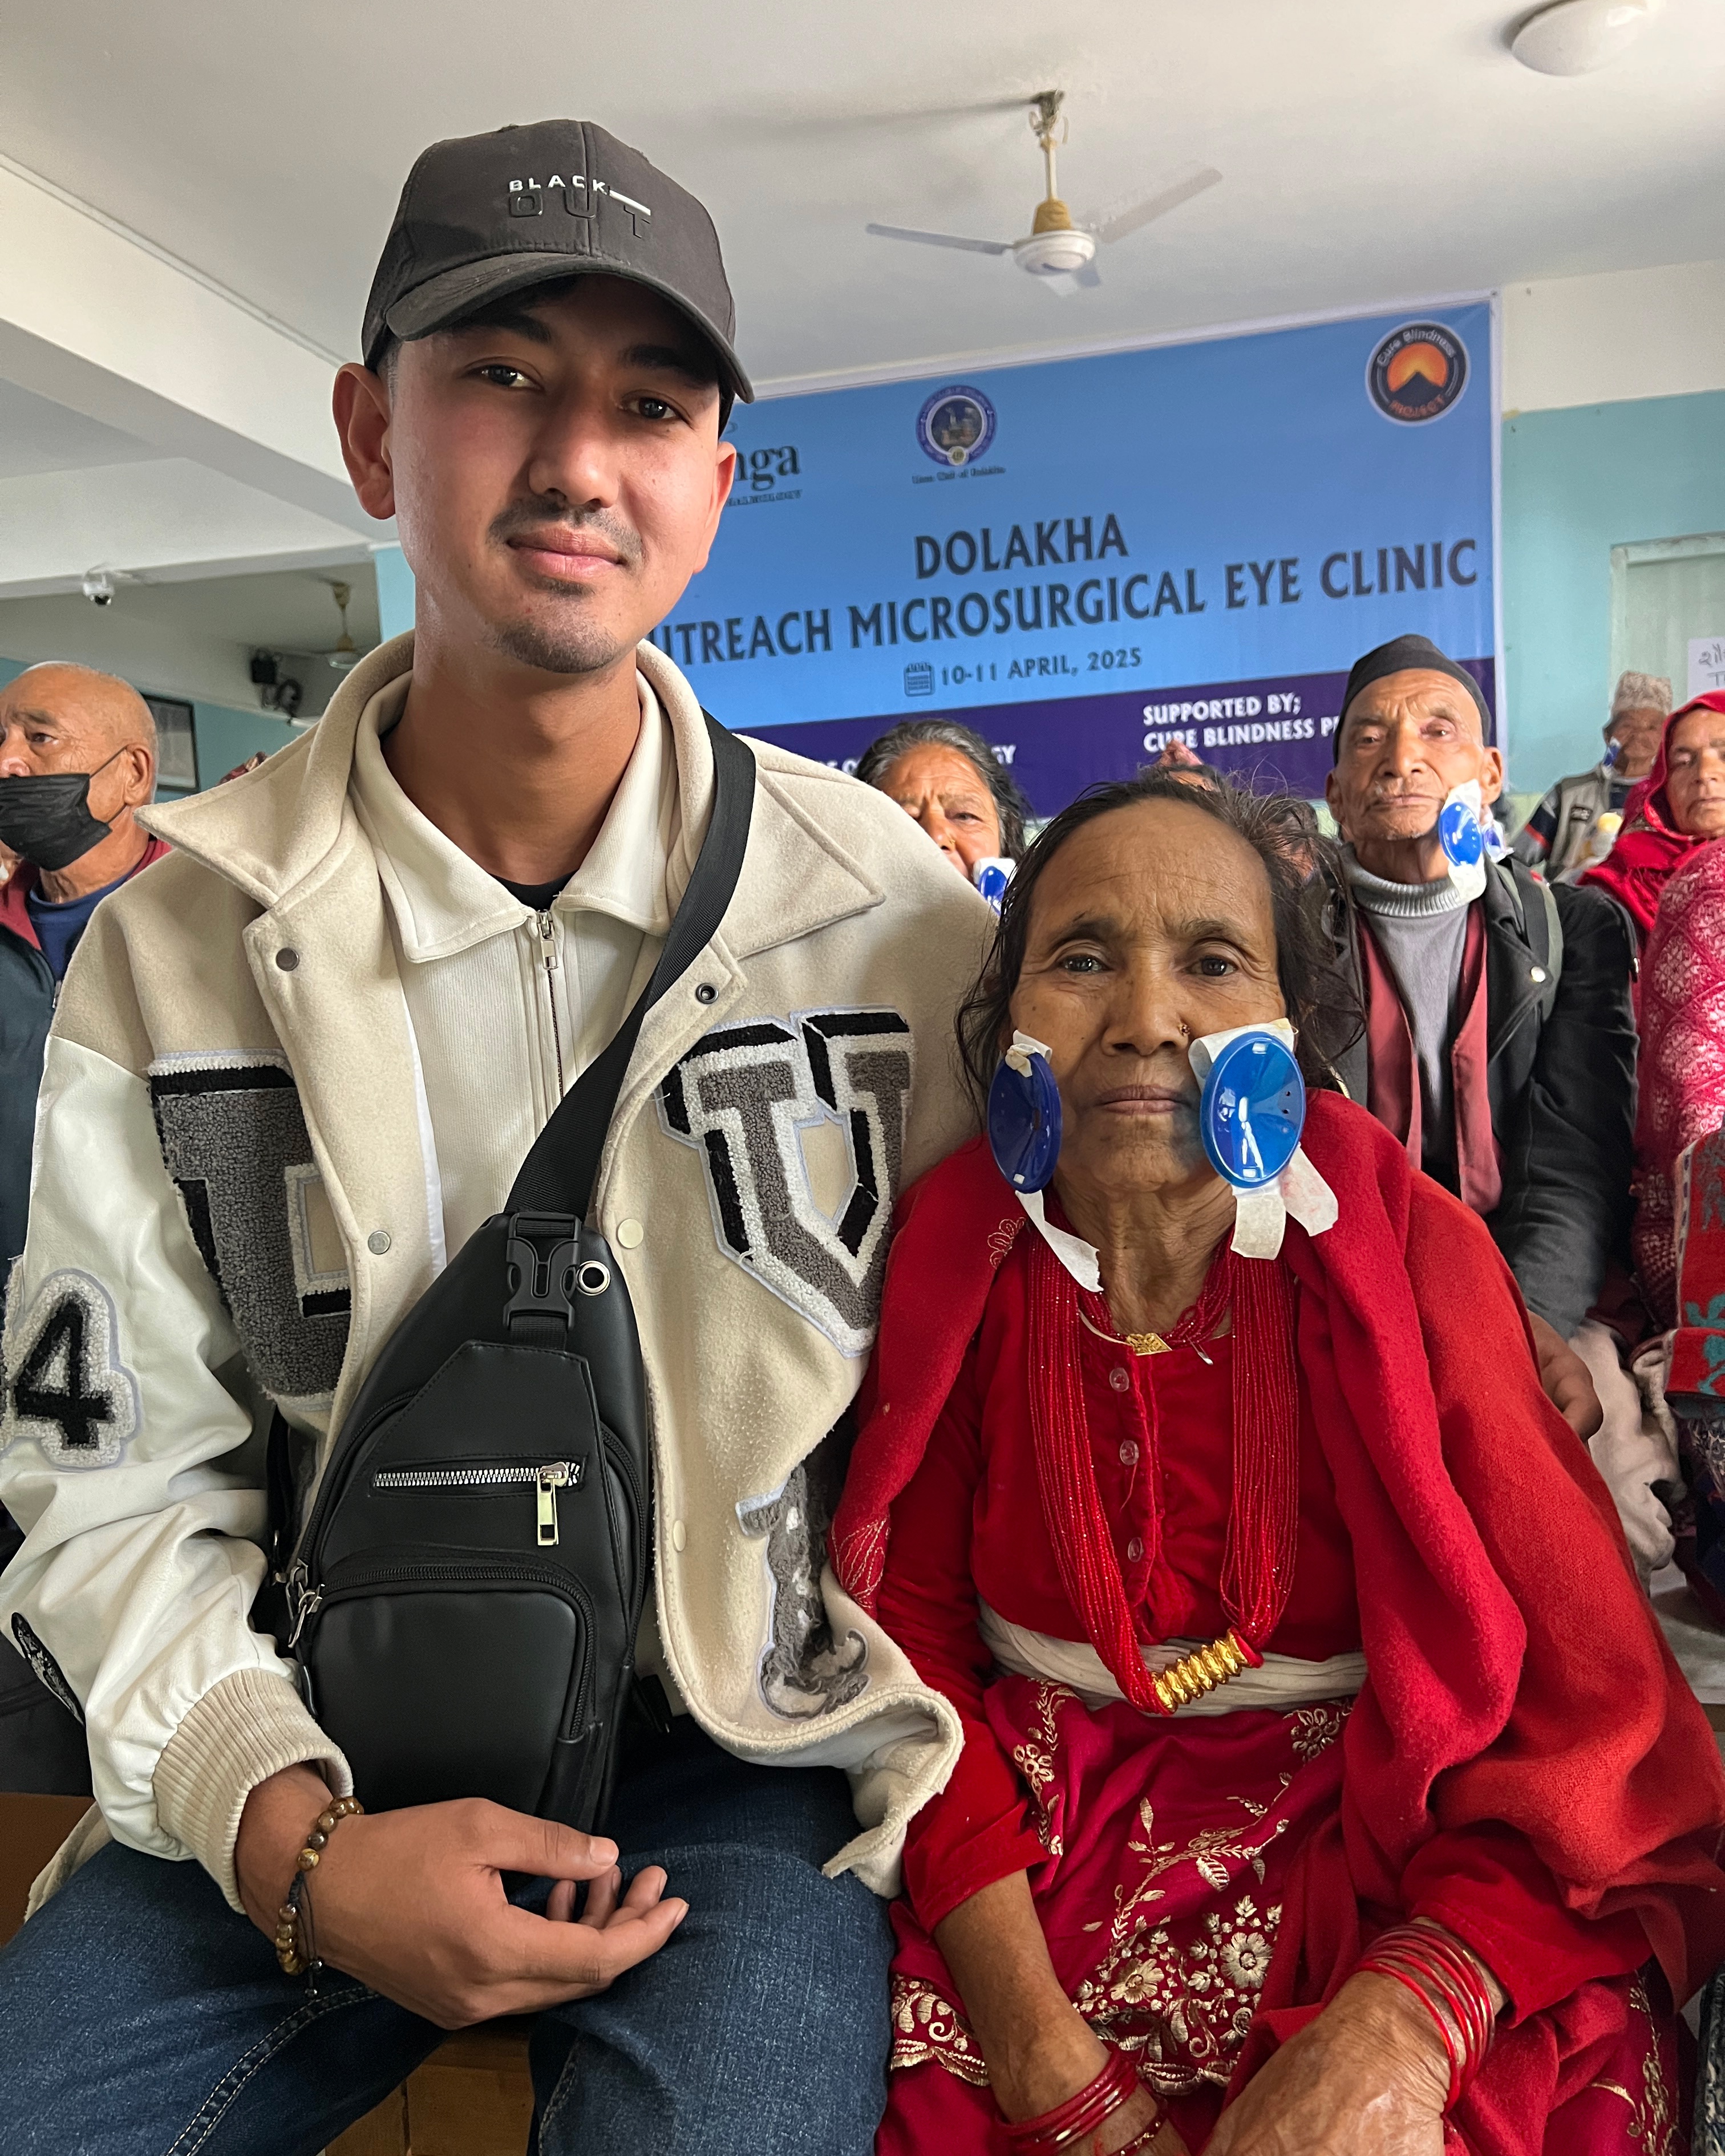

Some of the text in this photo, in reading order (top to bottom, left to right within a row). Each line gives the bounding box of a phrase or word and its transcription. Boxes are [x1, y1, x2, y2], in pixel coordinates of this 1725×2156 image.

[509, 175, 608, 195] BLACK
[915, 513, 1129, 579] DOLAKHA
[847, 568, 1206, 649] MICROSURGICAL
[1225, 557, 1302, 609] EYE
[1320, 538, 1477, 599] CLINIC
[941, 647, 1142, 686] 10-11 APRIL, 2025
[1143, 696, 1262, 726] SUPPORTED
[1203, 716, 1315, 748] BLINDNESS
[7, 1278, 128, 1460] 4
